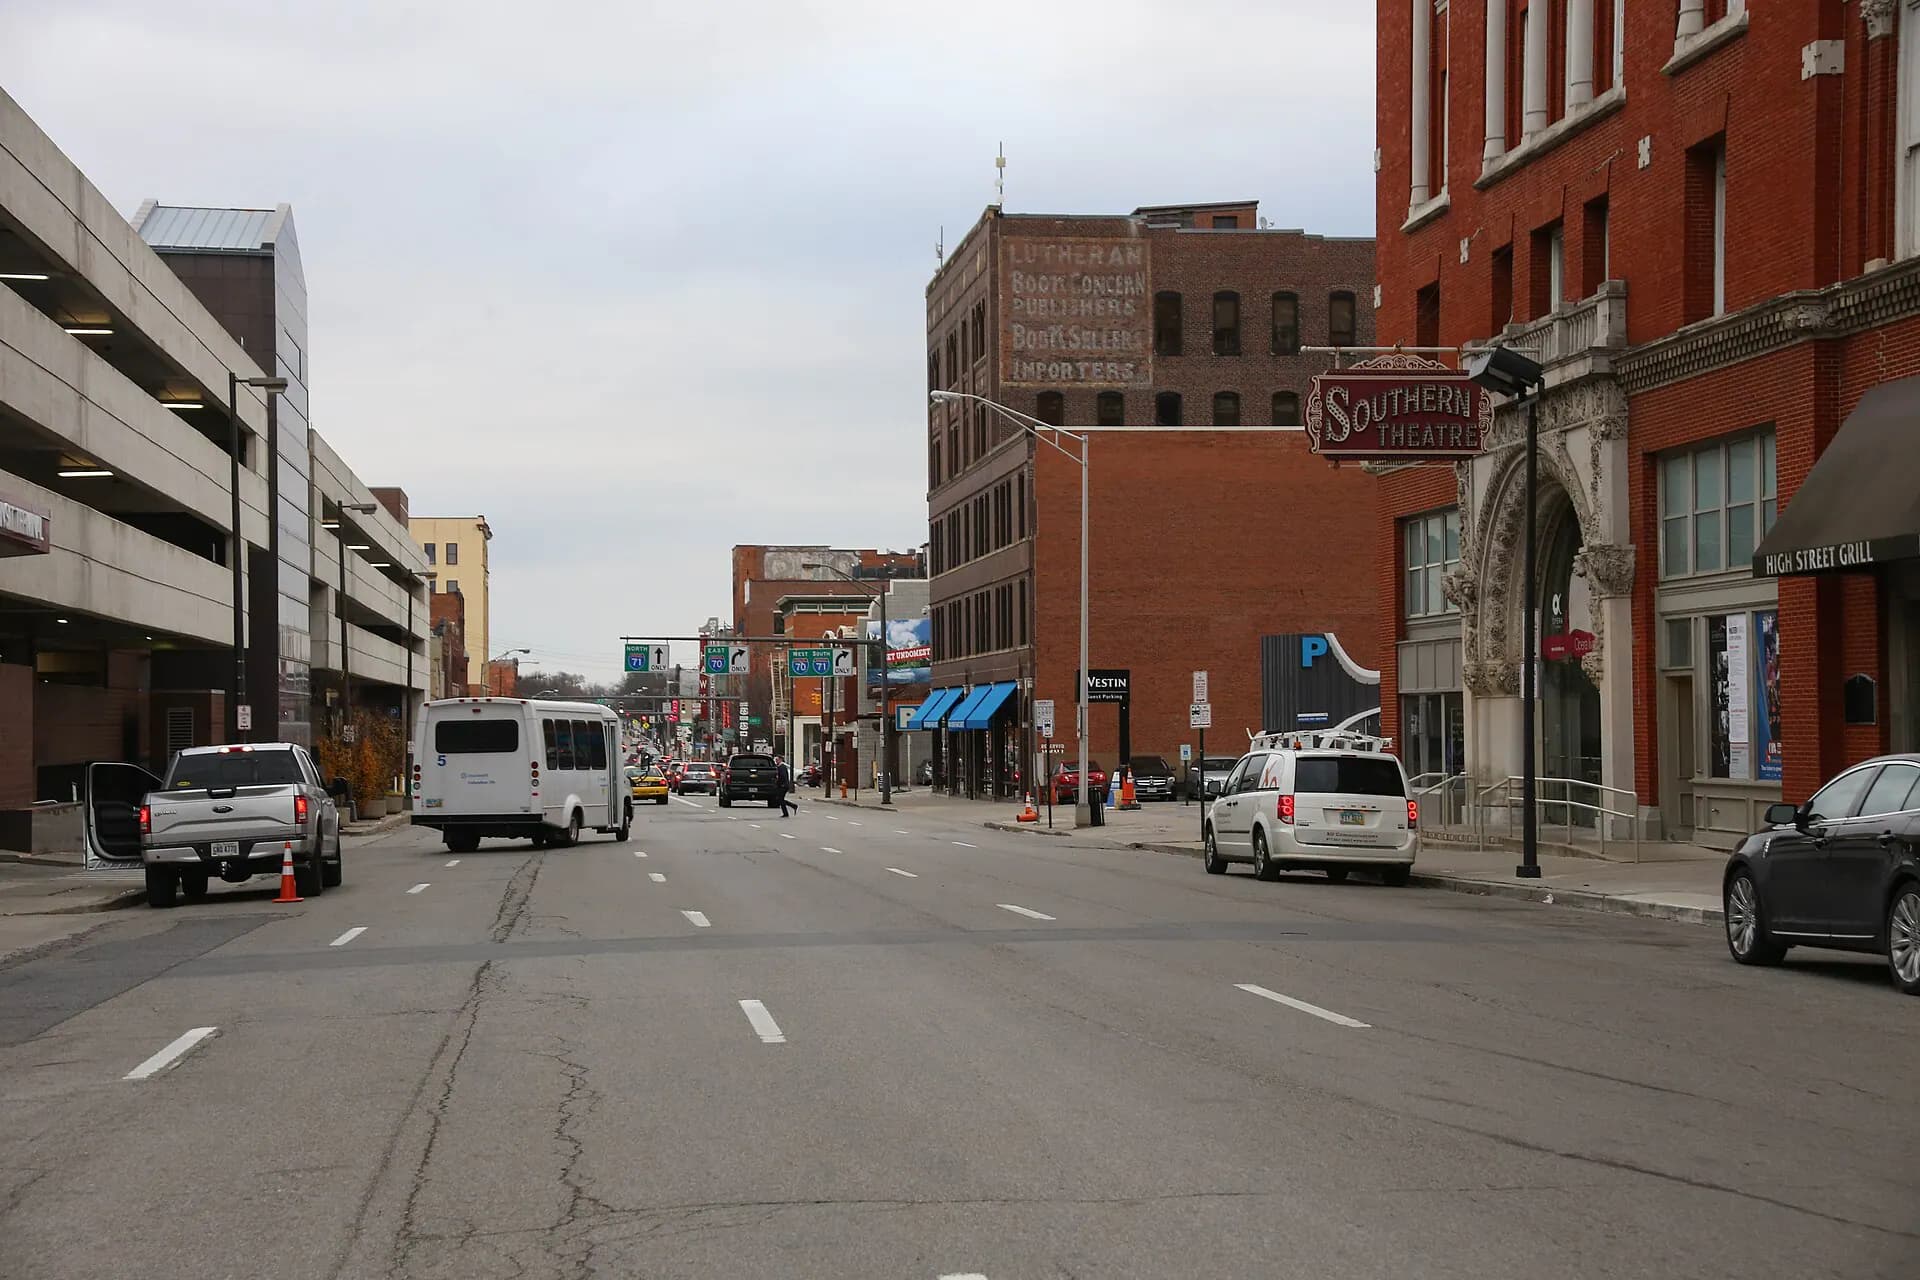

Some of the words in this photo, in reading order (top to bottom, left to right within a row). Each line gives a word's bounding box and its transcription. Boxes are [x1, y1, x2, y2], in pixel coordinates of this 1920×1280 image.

[1008, 244, 1142, 265] LUTHERAN
[1011, 270, 1065, 294] BOOK
[1070, 271, 1145, 296] CONCERN
[1012, 298, 1136, 317] PUBLISHERS
[1012, 358, 1134, 380] IMPORTERS
[1325, 384, 1471, 443] SOUTHERN
[1376, 423, 1478, 447] THEATRE
[1766, 553, 1793, 575] HIGH
[1796, 546, 1835, 571] STREET
[1839, 540, 1873, 566] GRILL
[631, 658, 642, 666] 71
[1302, 637, 1328, 667] P
[711, 660, 723, 668] 70
[795, 662, 806, 671] 70
[815, 662, 826, 671] 71
[437, 754, 447, 767] 5
